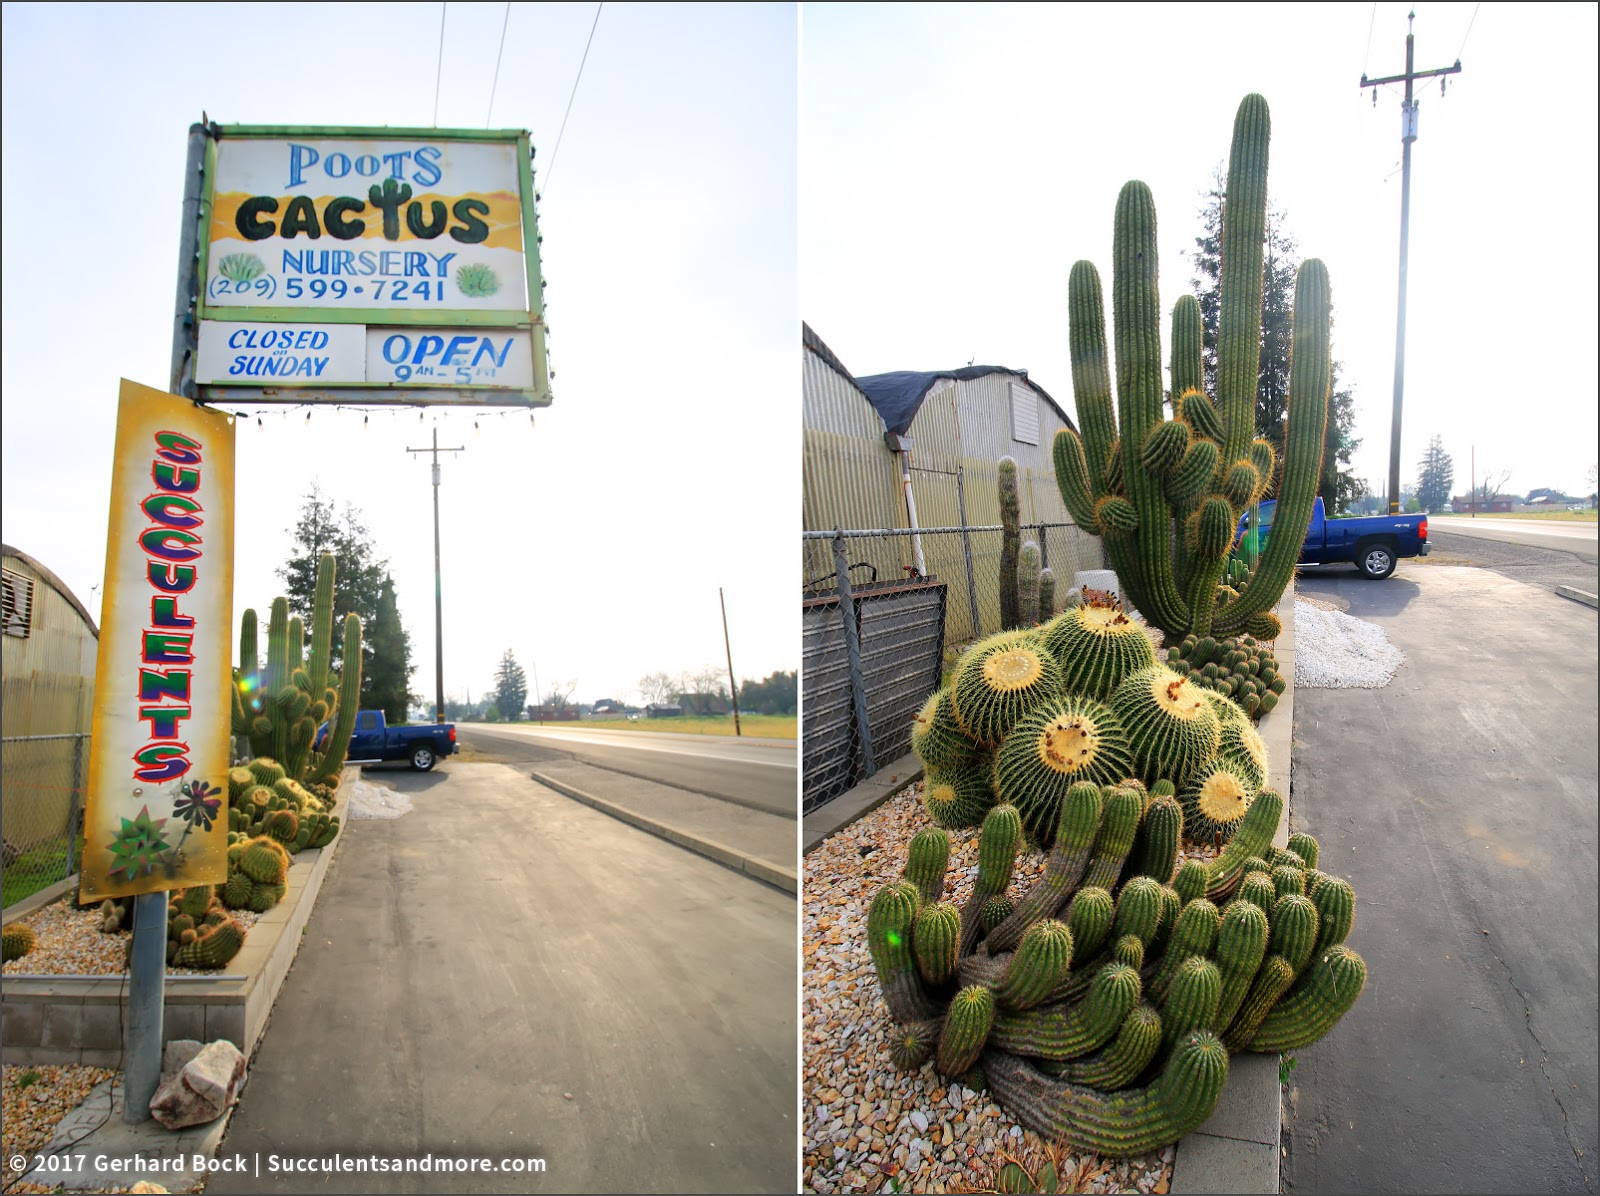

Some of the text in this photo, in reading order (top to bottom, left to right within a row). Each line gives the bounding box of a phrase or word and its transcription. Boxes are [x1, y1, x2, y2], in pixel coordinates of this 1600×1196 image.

[285, 142, 443, 189] POOTS
[235, 177, 490, 244] CACTUS
[282, 249, 458, 277] NURSERY
[209, 274, 277, 299] (209)
[228, 329, 329, 350] CLOSED
[382, 334, 514, 368] OPEN
[228, 355, 330, 377] SUNDAY
[133, 430, 204, 784] SUCCULENTS
